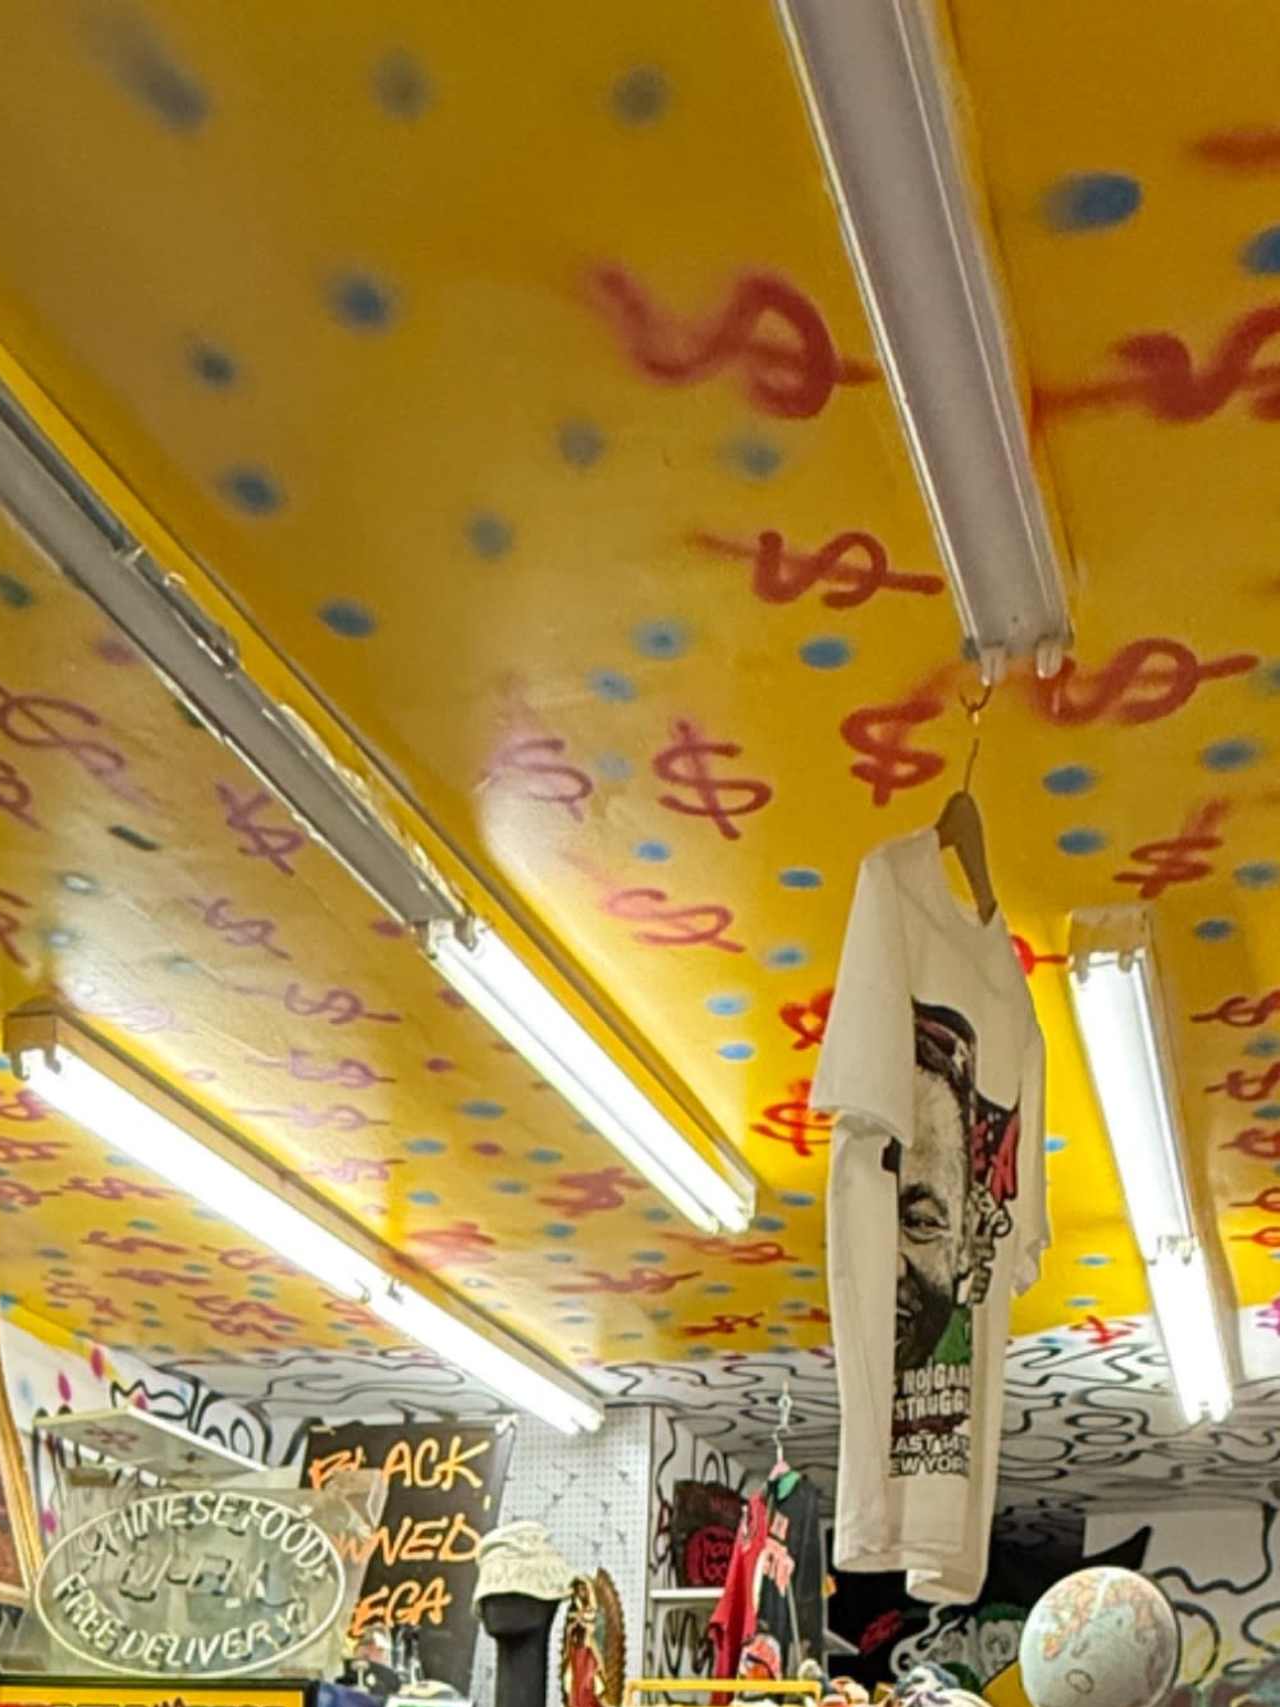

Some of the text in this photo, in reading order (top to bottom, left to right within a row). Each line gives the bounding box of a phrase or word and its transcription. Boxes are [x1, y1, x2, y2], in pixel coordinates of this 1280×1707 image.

[894, 1388, 971, 1421] STRUGG
[80, 1490, 335, 1568] CHINESE FOOD
[332, 1513, 484, 1567] WNED
[53, 1571, 128, 1650] FREE
